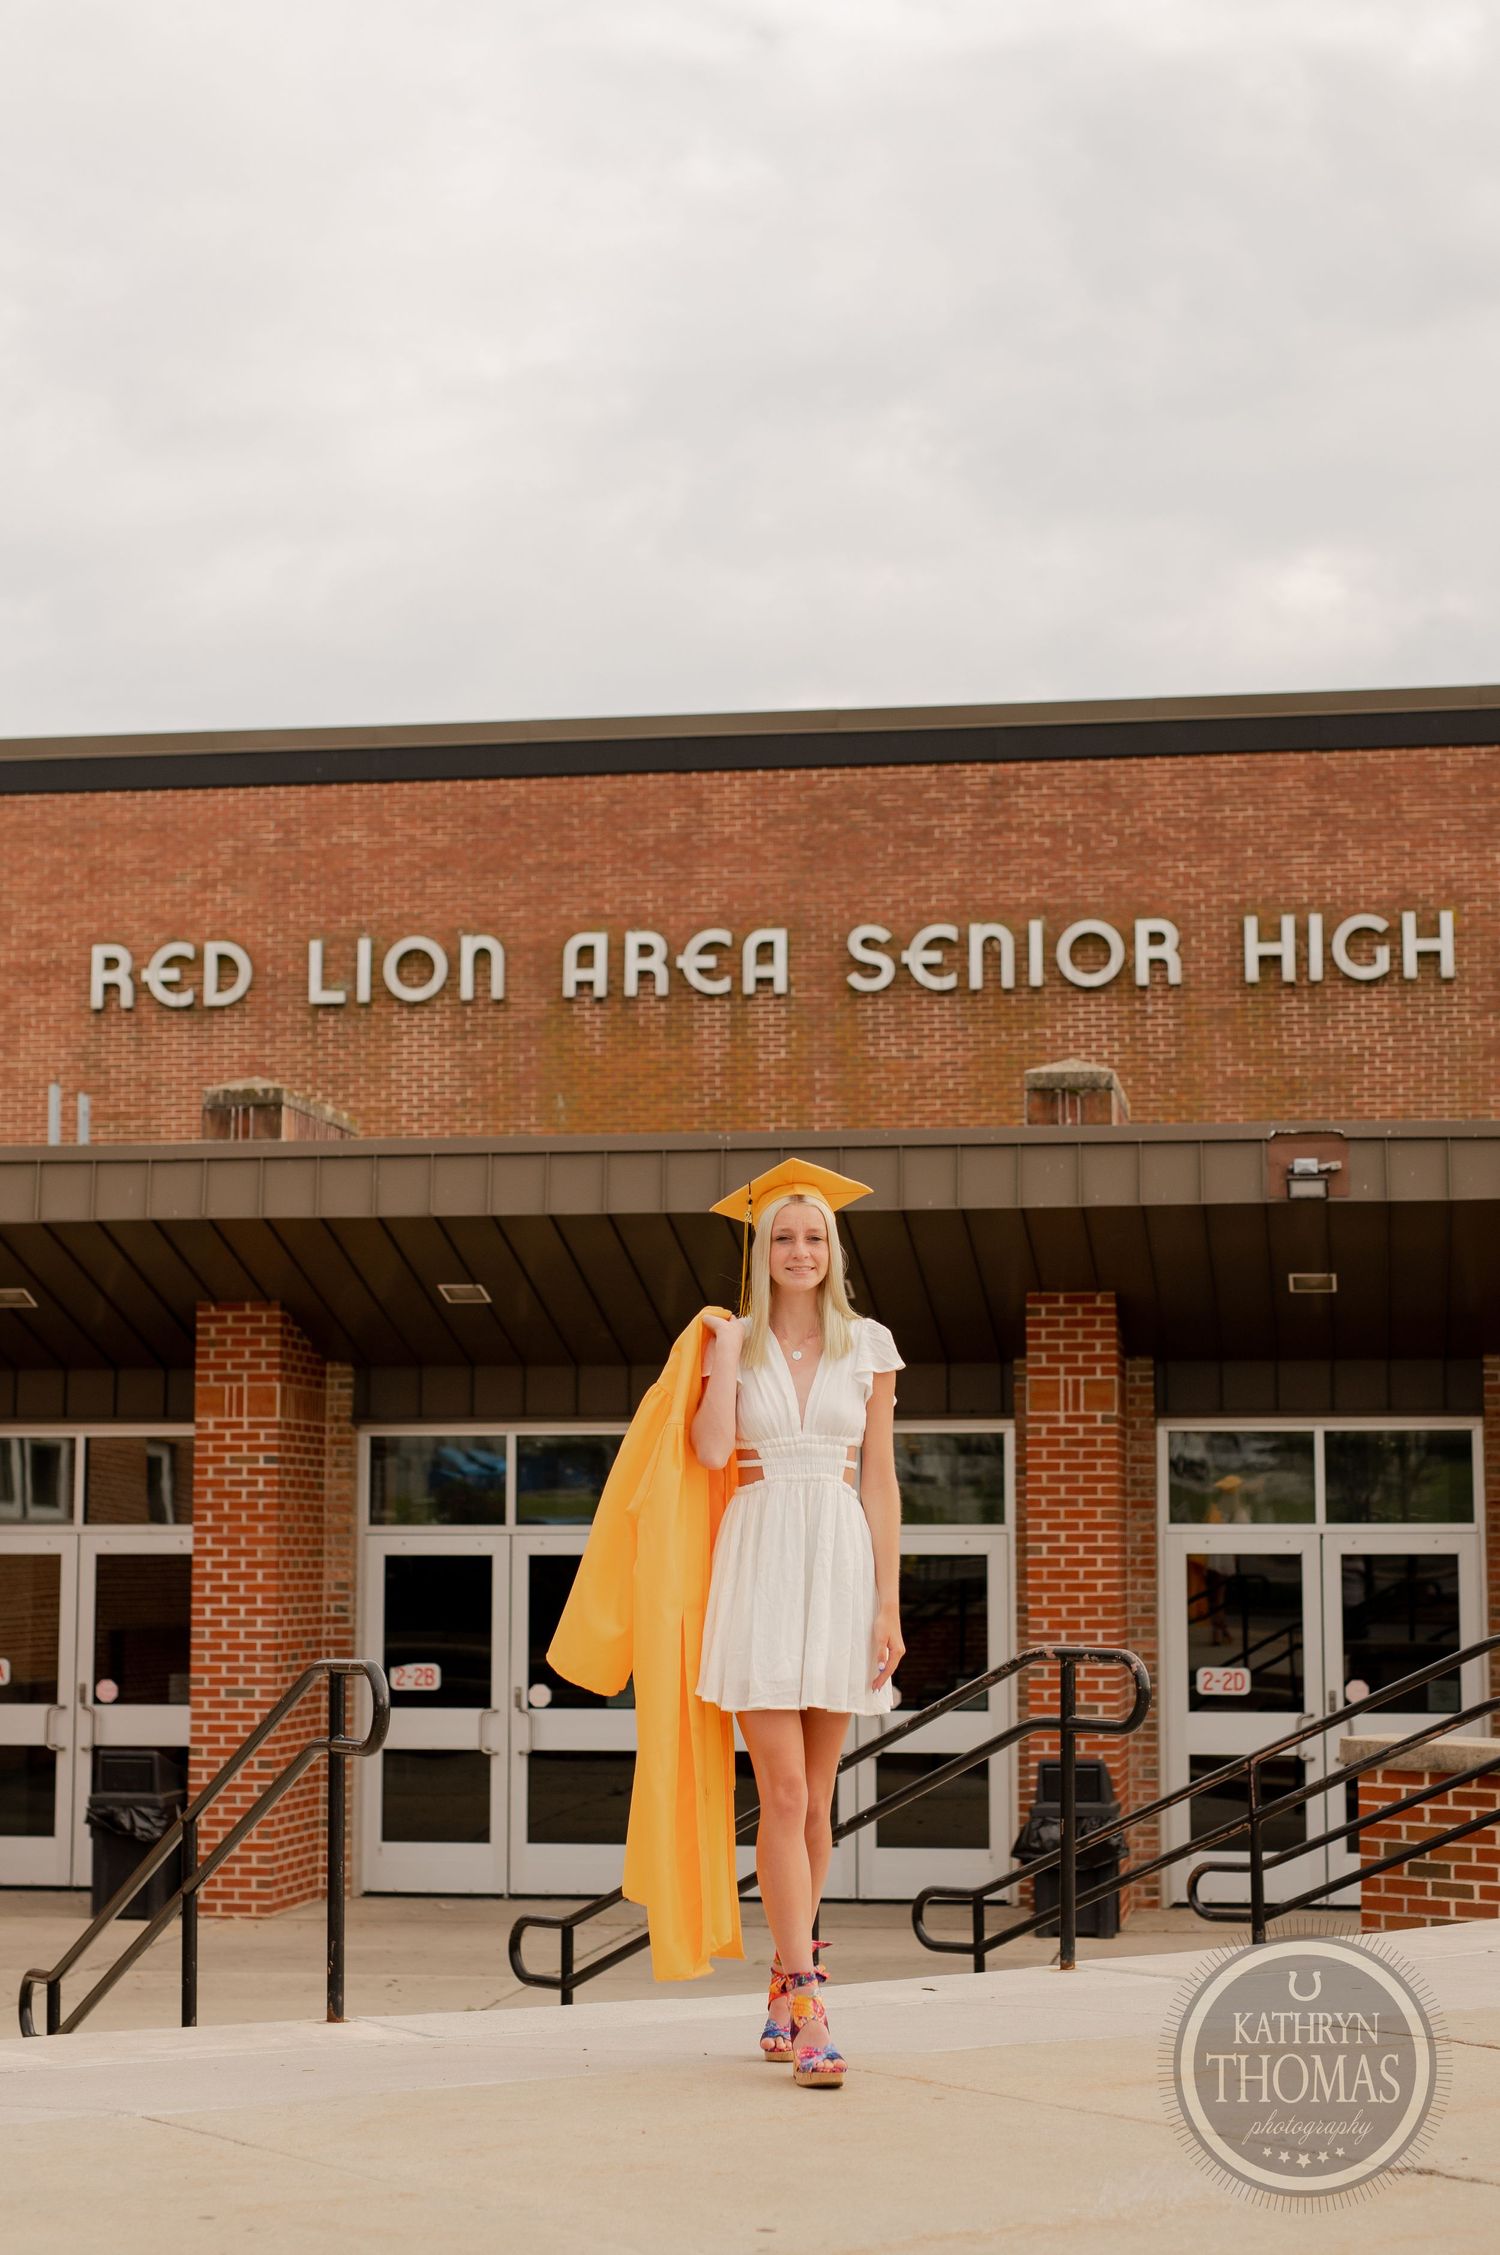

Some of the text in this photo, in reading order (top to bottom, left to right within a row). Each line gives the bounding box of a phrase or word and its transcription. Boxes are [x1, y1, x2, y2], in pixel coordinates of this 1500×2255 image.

[89, 910, 1456, 1010] RED LION AREA SENIOR HIGH
[394, 1666, 435, 1687] 2-2B
[1202, 1671, 1246, 1692] 2-2D
